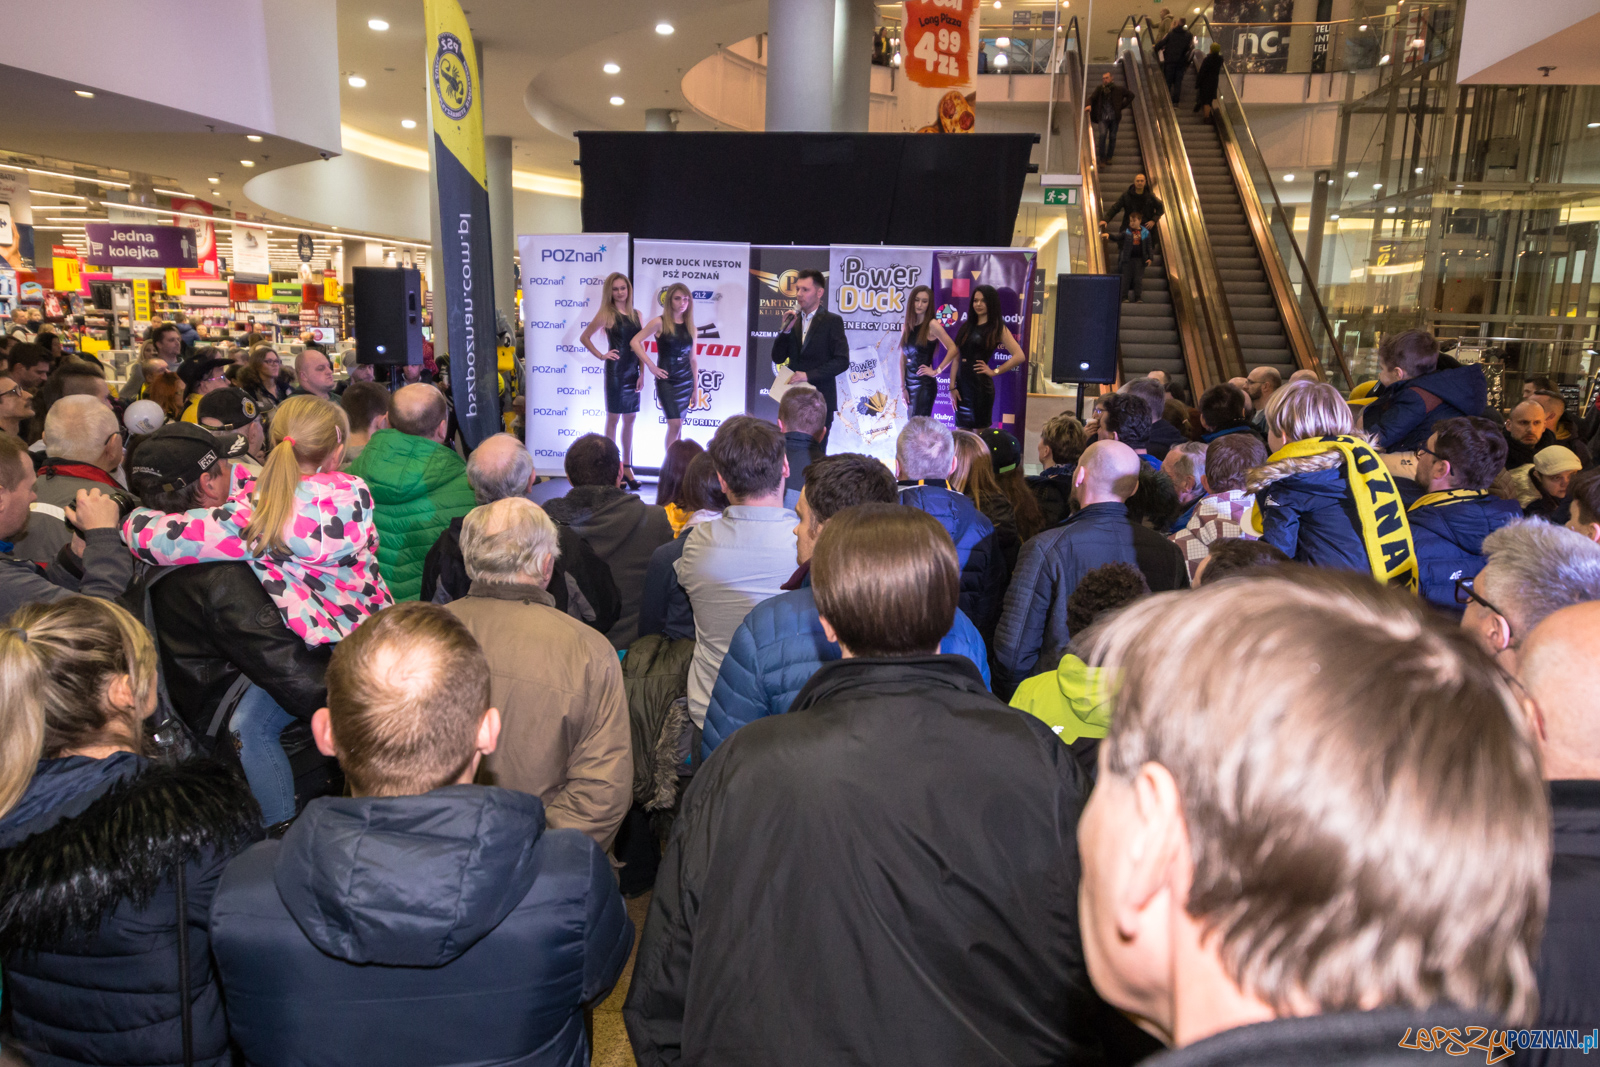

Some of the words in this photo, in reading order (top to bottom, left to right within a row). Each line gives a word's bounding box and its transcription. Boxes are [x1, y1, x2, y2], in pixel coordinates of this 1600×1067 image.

[918, 16, 940, 28] Long
[940, 13, 962, 28] Pizza
[914, 31, 938, 72] 4
[938, 28, 961, 53] 99
[110, 230, 154, 242] Jedna
[108, 246, 159, 260] kolejka
[642, 258, 674, 266] POWER
[676, 258, 700, 267] DUCK
[703, 260, 742, 268] IVESTON
[663, 269, 679, 278] PSŻ
[682, 271, 719, 280] POZNAŃ
[842, 255, 921, 290] Power
[838, 286, 904, 313] Duck
[843, 321, 880, 330] ENERGY
[994, 352, 1012, 360] fitne
[693, 418, 720, 427] DRINK
